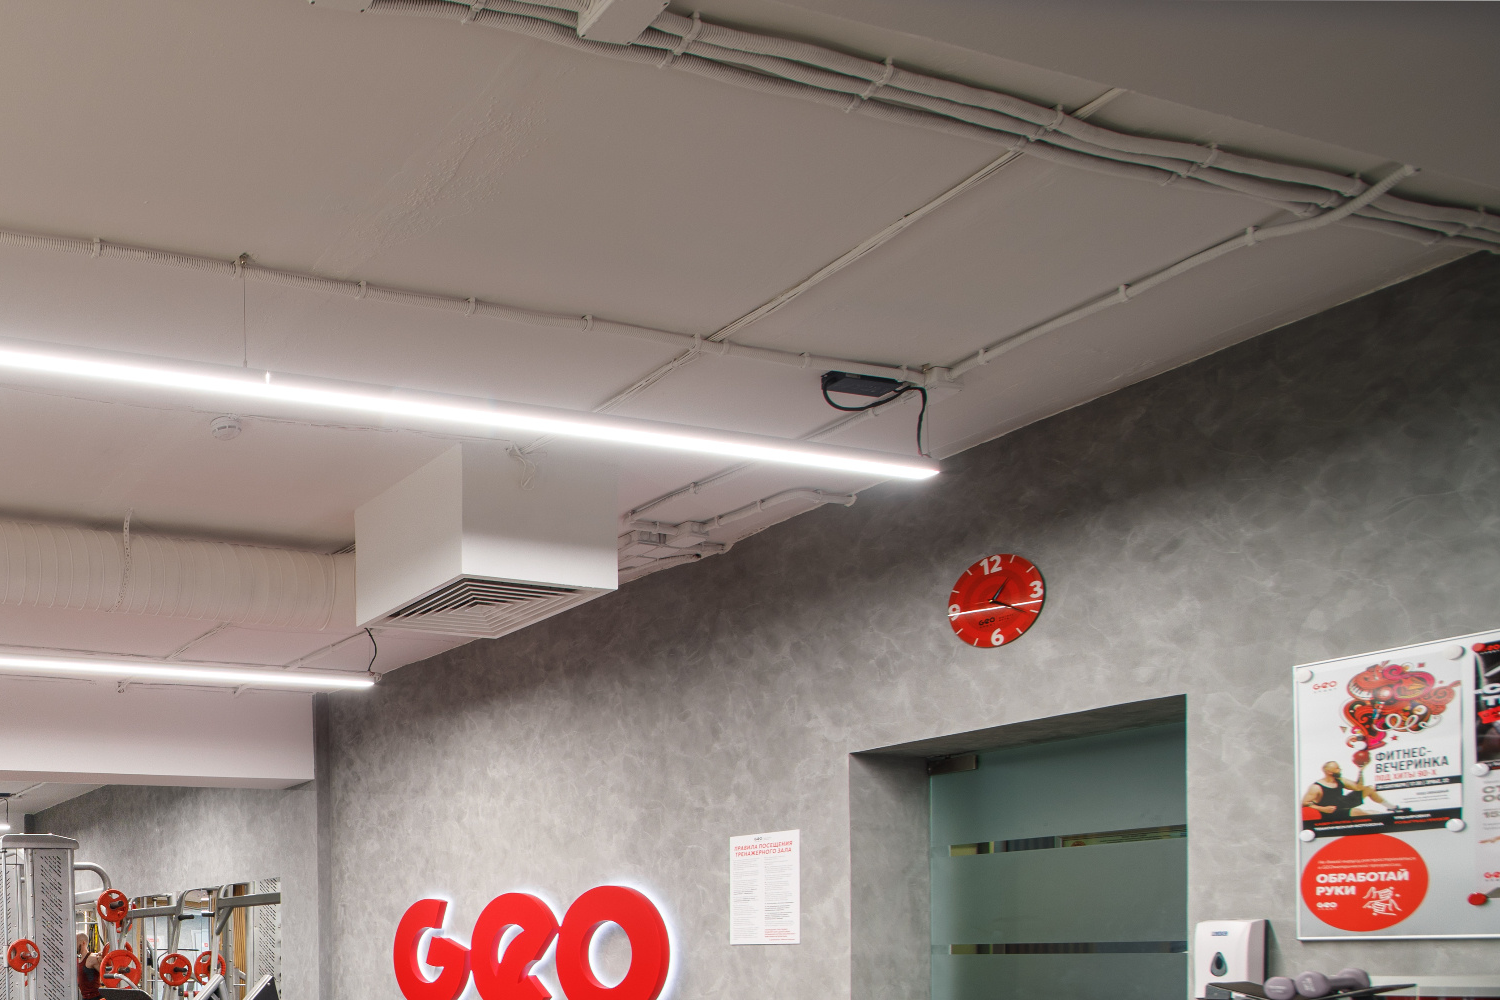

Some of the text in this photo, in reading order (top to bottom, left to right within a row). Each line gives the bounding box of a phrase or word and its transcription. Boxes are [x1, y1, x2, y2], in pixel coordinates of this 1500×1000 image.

[979, 554, 1003, 576] 12
[1029, 580, 1043, 598] 3
[948, 603, 961, 621] 9
[990, 628, 1004, 646] 6
[1375, 746, 1432, 761] ФИТНЕС-
[1375, 755, 1449, 774] ВЕЧЕРИНКА
[735, 848, 777, 858] ТРЕНАЖЕРНОГО
[758, 840, 793, 849] ПОСЕЩЕНИЯ
[1316, 868, 1410, 884] ОБРАБОТАЙ
[1316, 885, 1357, 896] РУКИ
